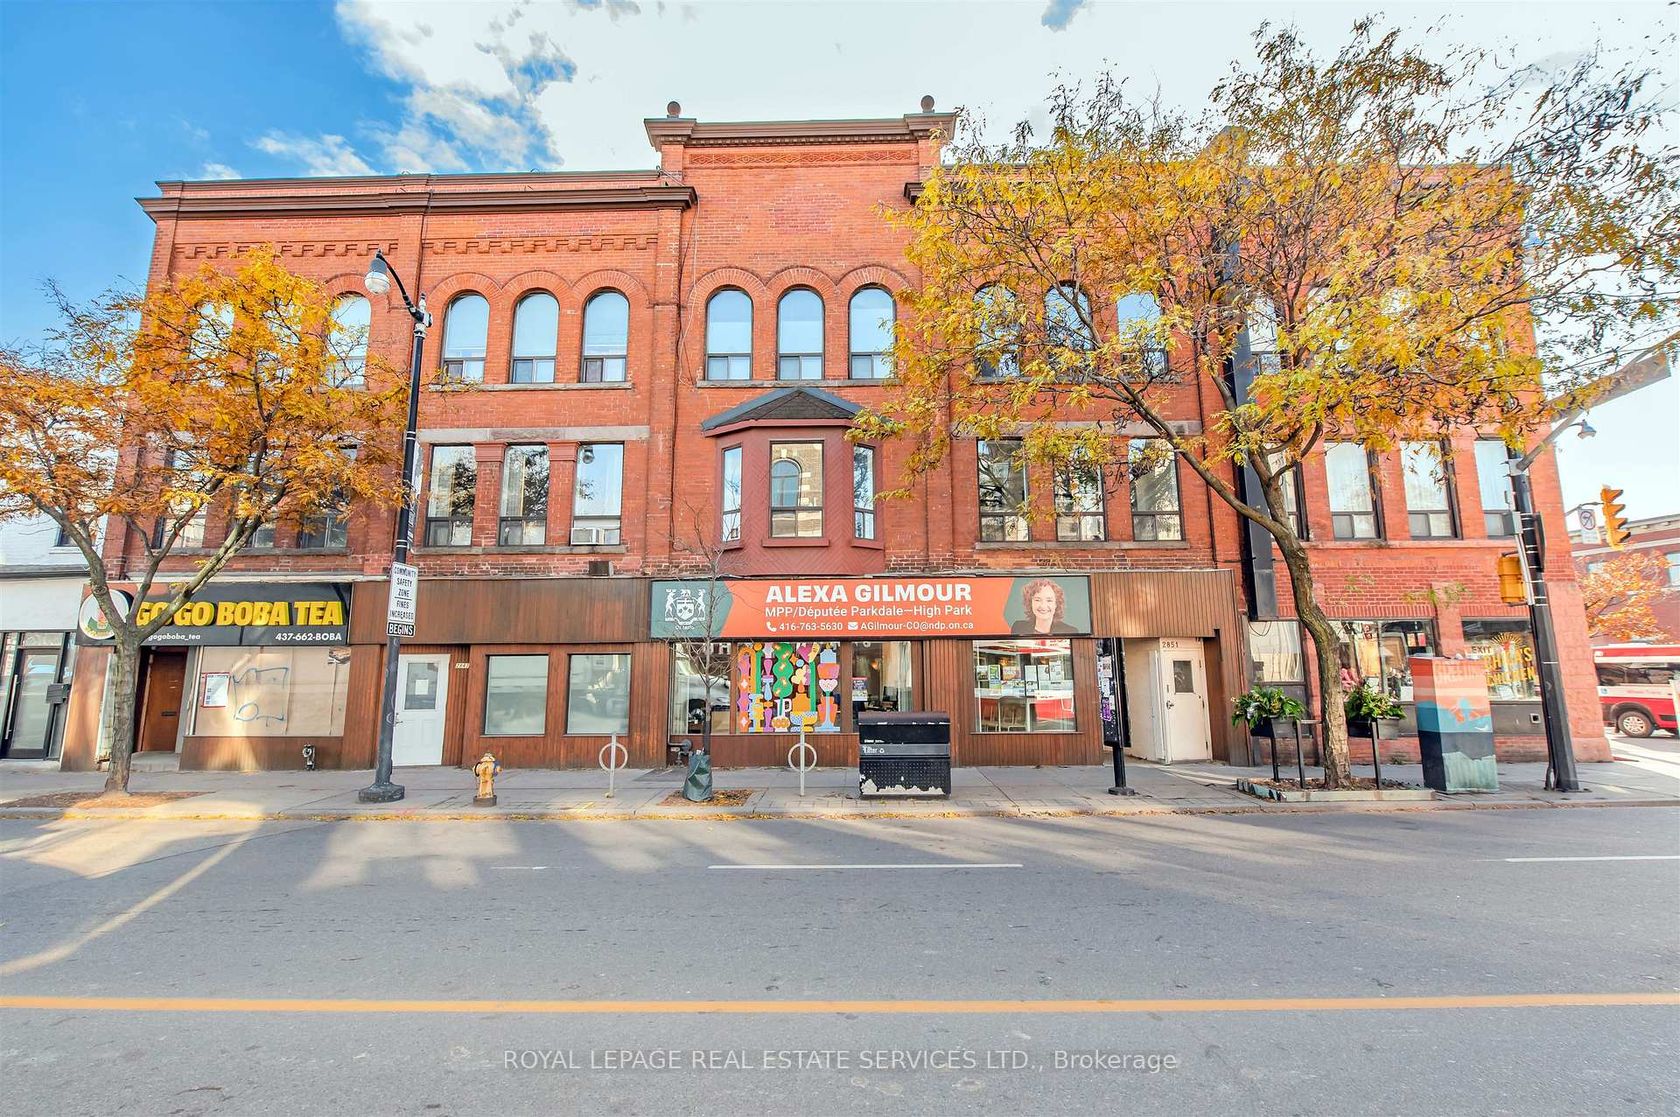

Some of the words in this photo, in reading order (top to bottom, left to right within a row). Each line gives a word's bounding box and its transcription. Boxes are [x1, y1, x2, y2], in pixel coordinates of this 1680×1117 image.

[396, 578, 412, 587] SAFETY
[398, 588, 410, 598] ZONE
[766, 585, 848, 603] ALEXA
[854, 583, 972, 602] GILMOUR
[396, 600, 410, 609] FINES
[216, 601, 290, 626] BOBA
[294, 601, 344, 626] TEA
[765, 605, 848, 618] MPP/Députée
[945, 604, 972, 615] Park
[388, 623, 413, 636] BEGINS
[779, 621, 843, 631] 416-763-5630
[860, 620, 974, 632] AGilmour-CO@ndp.on.ca
[275, 632, 342, 641] 437-662-BOBA
[1471, 645, 1492, 655] EXIT
